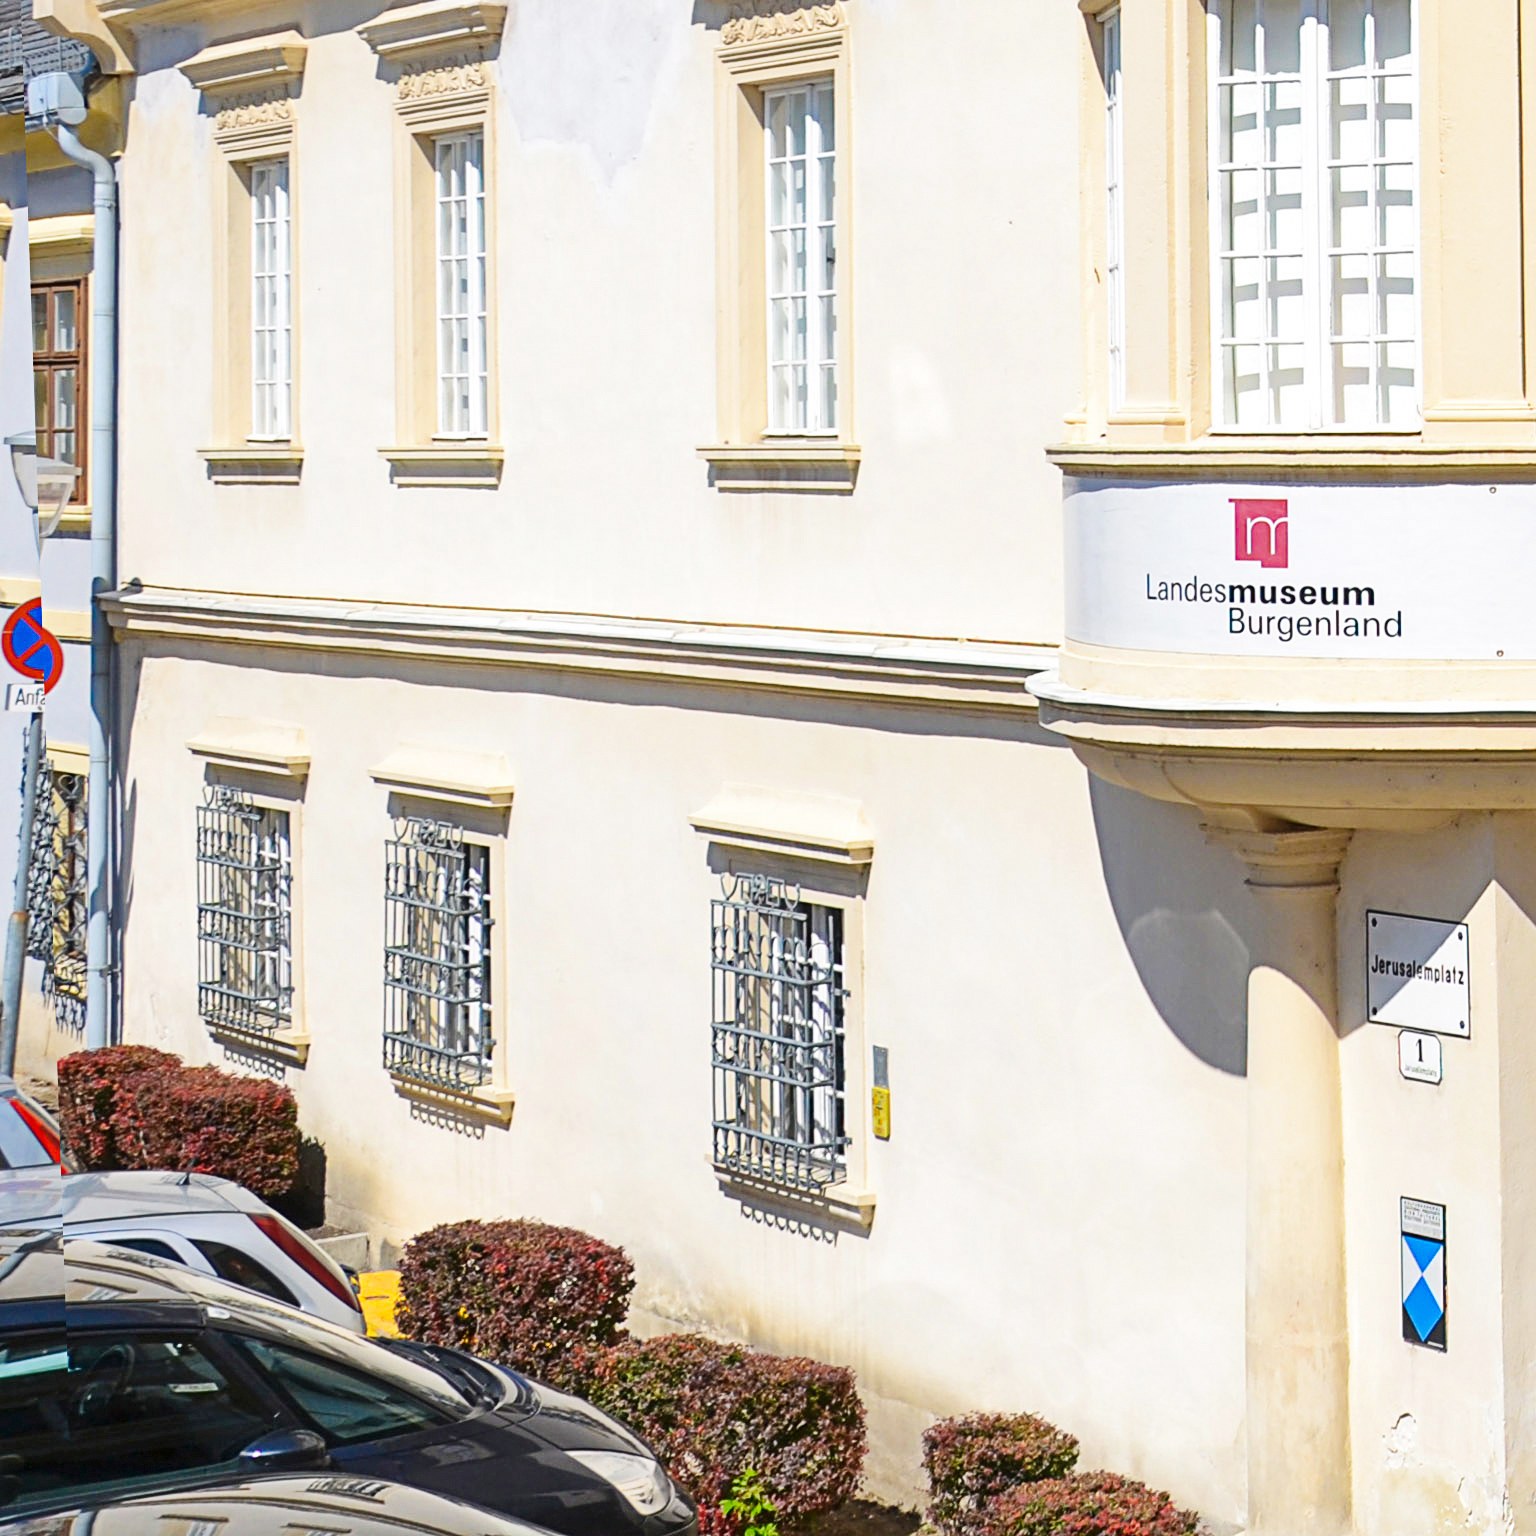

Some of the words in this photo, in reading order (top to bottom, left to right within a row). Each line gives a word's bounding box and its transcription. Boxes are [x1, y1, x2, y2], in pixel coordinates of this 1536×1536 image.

[1146, 573, 1375, 606] Landesmuseum
[1229, 607, 1402, 642] Burgenland
[1371, 954, 1465, 985] Jerusalemplatz
[1415, 1038, 1424, 1063] 1
